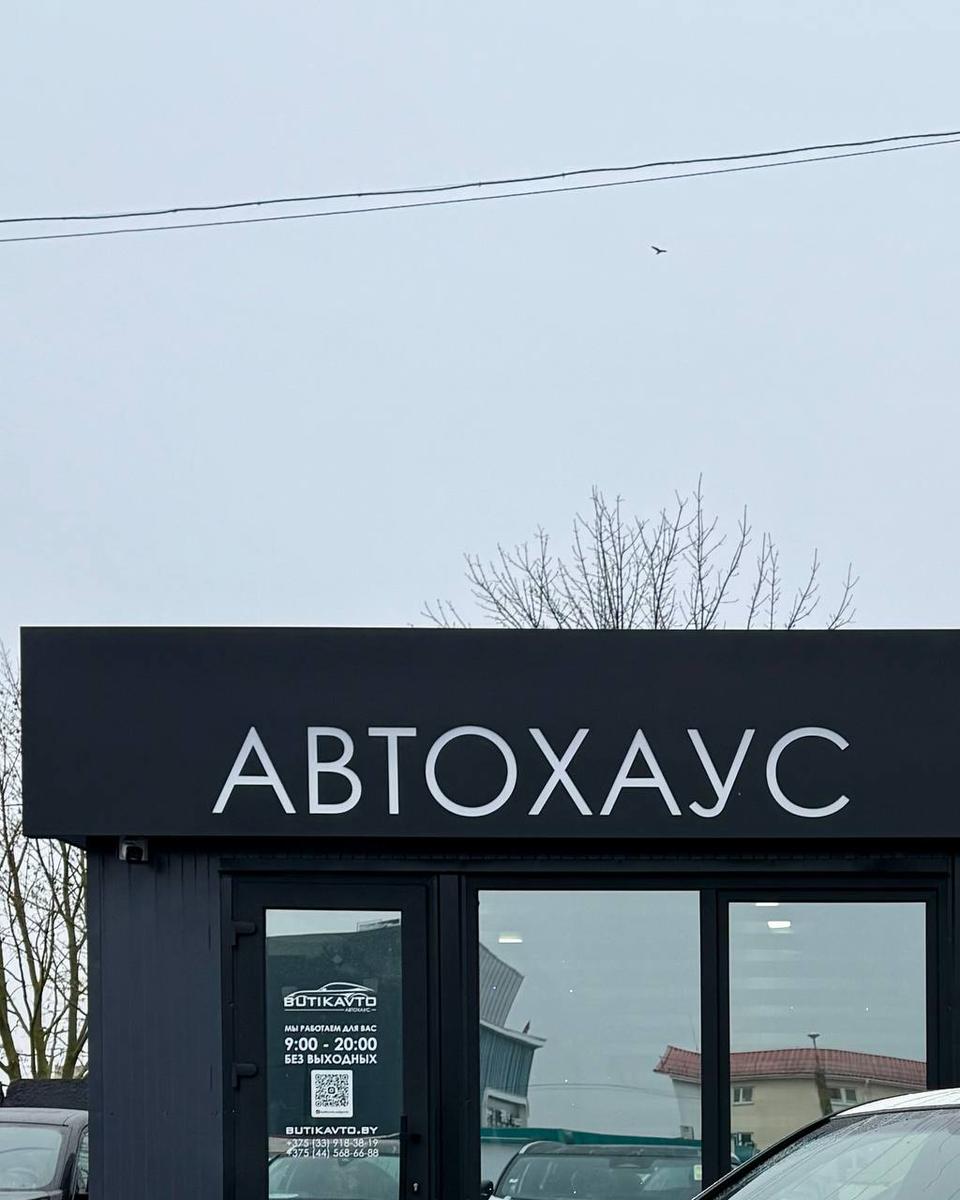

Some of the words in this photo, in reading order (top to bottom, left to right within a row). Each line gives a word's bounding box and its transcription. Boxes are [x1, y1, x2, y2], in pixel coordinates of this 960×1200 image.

[211, 726, 850, 819] АВТОХАУС
[283, 995, 377, 1007] BUTIKAVTO
[342, 1025, 359, 1033] ДЛЯ
[284, 1037, 318, 1051] 9:00
[334, 1037, 378, 1051] 20:00
[284, 1054, 304, 1064] БЕЗ
[307, 1054, 378, 1065] ВЫХОДНЫХ
[286, 1126, 378, 1135] BUTIKAVTO.BY
[287, 1138, 309, 1147] +375
[312, 1138, 330, 1148] (33)
[333, 1138, 379, 1147] 918-38-19
[287, 1148, 309, 1158] +375
[312, 1148, 330, 1159] (44)
[333, 1148, 379, 1158] 568-66-88
